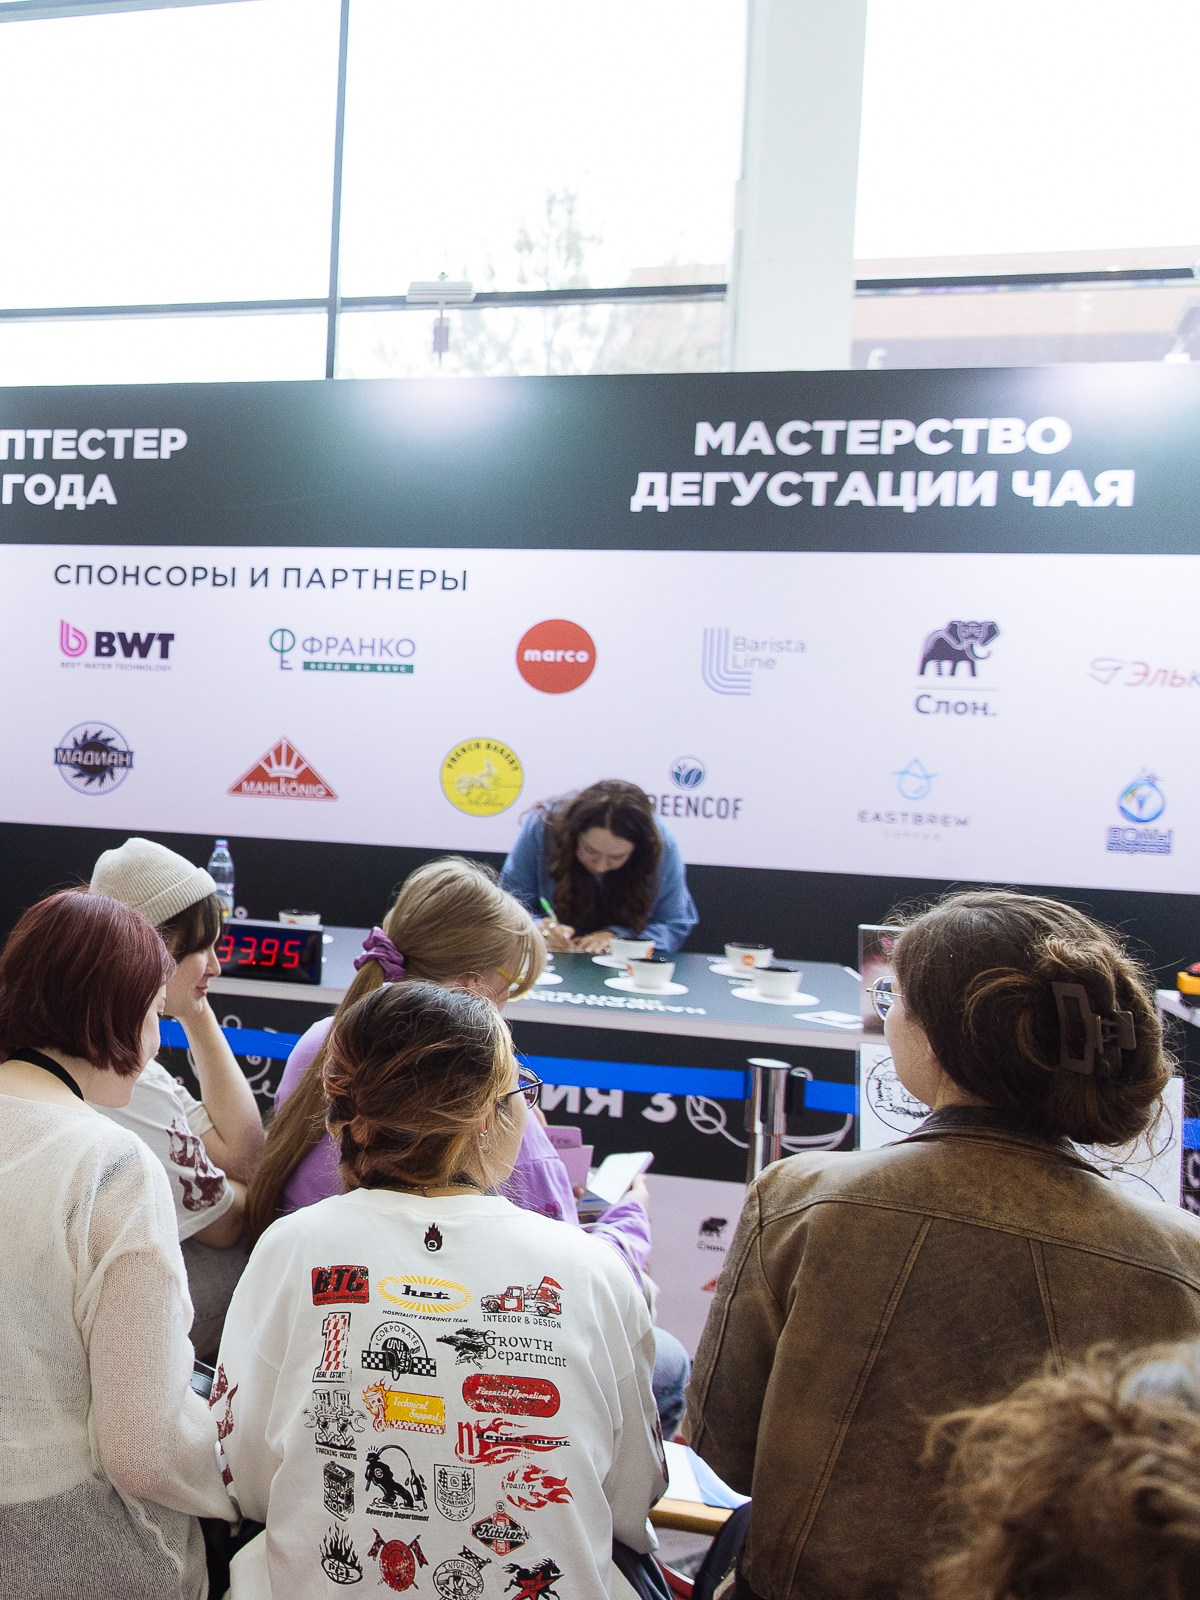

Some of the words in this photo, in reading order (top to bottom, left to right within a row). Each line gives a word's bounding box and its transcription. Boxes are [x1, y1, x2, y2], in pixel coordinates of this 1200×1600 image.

[694, 416, 1072, 456] МАСТЕРСТВО
[1, 473, 118, 511] ГОДА
[630, 471, 998, 512] ДЕГУСТАЦИИ
[1011, 469, 1135, 507] ЧАЯ
[54, 564, 236, 588] СПОНСОРЫ
[250, 567, 269, 589] И
[283, 568, 468, 591] ПАРТНЕРЫ
[95, 631, 175, 659] BWT
[302, 636, 416, 658] ФРАНКО
[732, 636, 807, 653] Barista
[523, 649, 590, 663] marco
[732, 655, 776, 670] Line
[56, 748, 133, 768] МАДИАН
[313, 1268, 366, 1294] BTC
[382, 1310, 417, 1319] HOSPITALITY
[483, 1314, 522, 1324] INTERIOR
[524, 1317, 531, 1325] &
[533, 1318, 562, 1329] DESIGN
[375, 1325, 420, 1346] CORPORATE
[485, 1346, 567, 1367] Department
[476, 1386, 512, 1399] Financial
[393, 1397, 429, 1410] Technical
[315, 1447, 338, 1457] TRAINING
[340, 1451, 358, 1460] ROOMS
[365, 1507, 394, 1518] Beverage
[394, 1511, 429, 1522] Department
[477, 1524, 526, 1540] Kitchen
